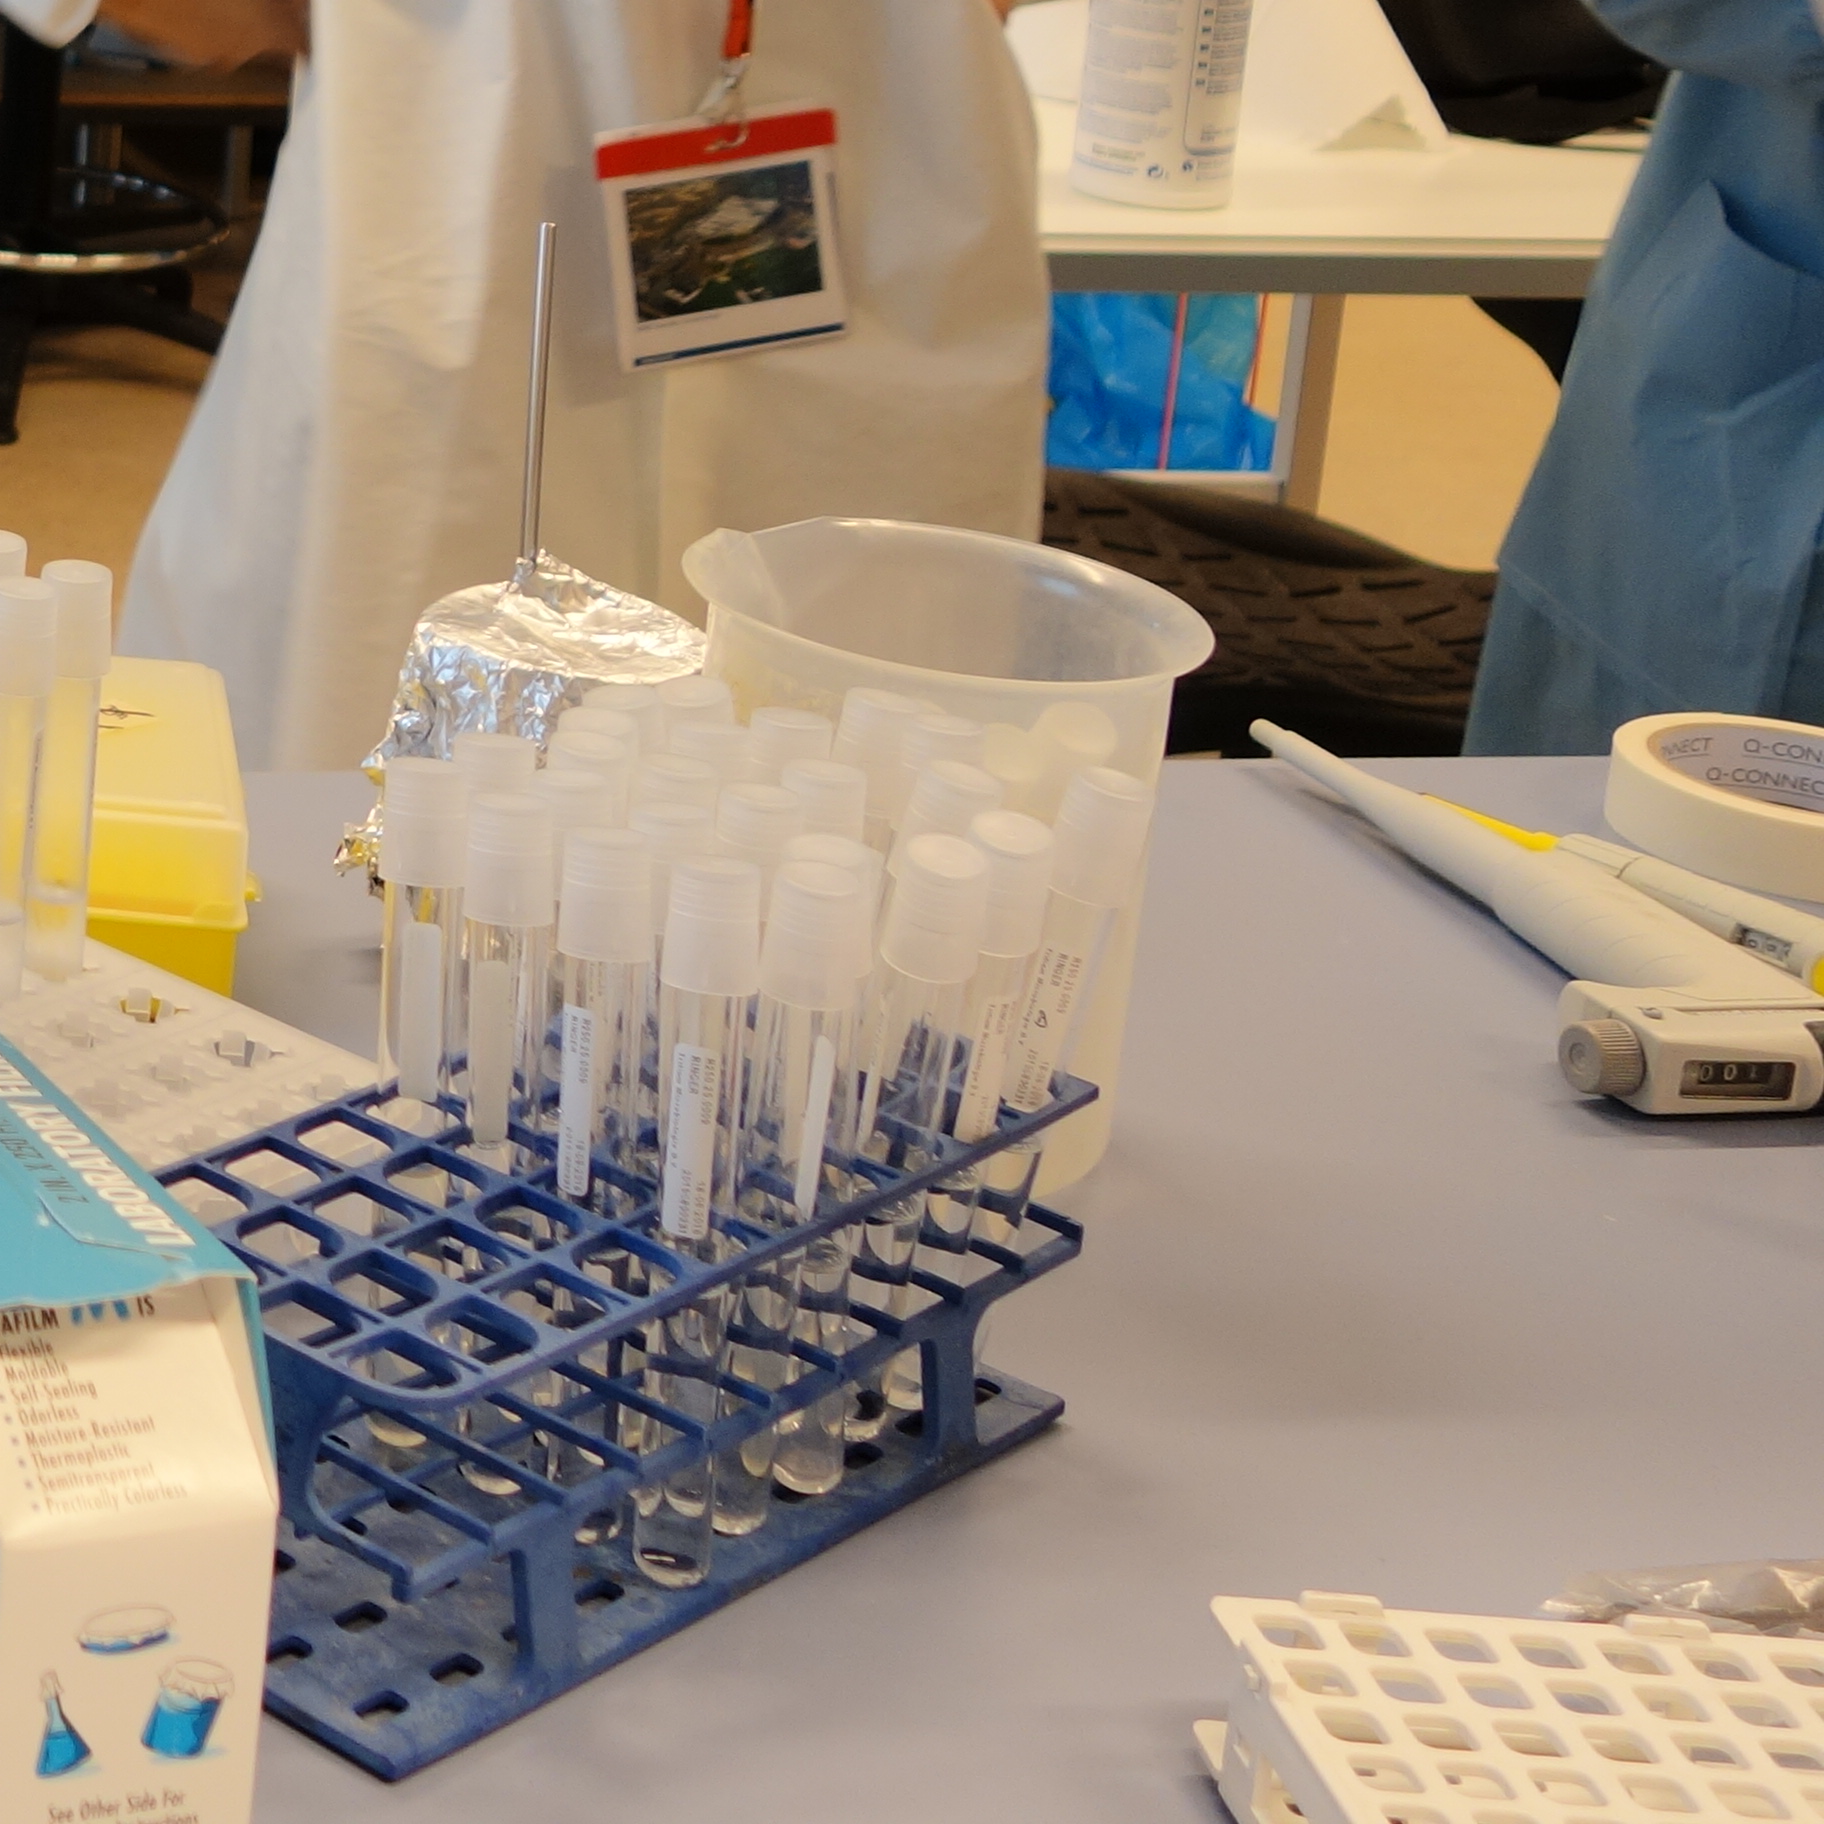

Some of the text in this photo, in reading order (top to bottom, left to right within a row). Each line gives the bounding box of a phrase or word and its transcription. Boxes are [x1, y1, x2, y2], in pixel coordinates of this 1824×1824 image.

[1743, 738, 1824, 763] Q-CON
[1705, 766, 1824, 796] Q-CONNEC
[688, 1055, 702, 1095] RINGER
[6, 1101, 197, 1247] LABORATORY
[136, 1294, 156, 1318] IS
[4, 1362, 69, 1385] Moldable
[17, 1405, 80, 1428] Odorless
[31, 1443, 131, 1472] Thermoplastic
[37, 1462, 156, 1493] Semitransparent
[45, 1481, 188, 1516] Practically Colorless
[47, 1802, 75, 1824] See
[79, 1793, 121, 1820] Other
[127, 1788, 157, 1814] Side
[162, 1788, 185, 1809] For
